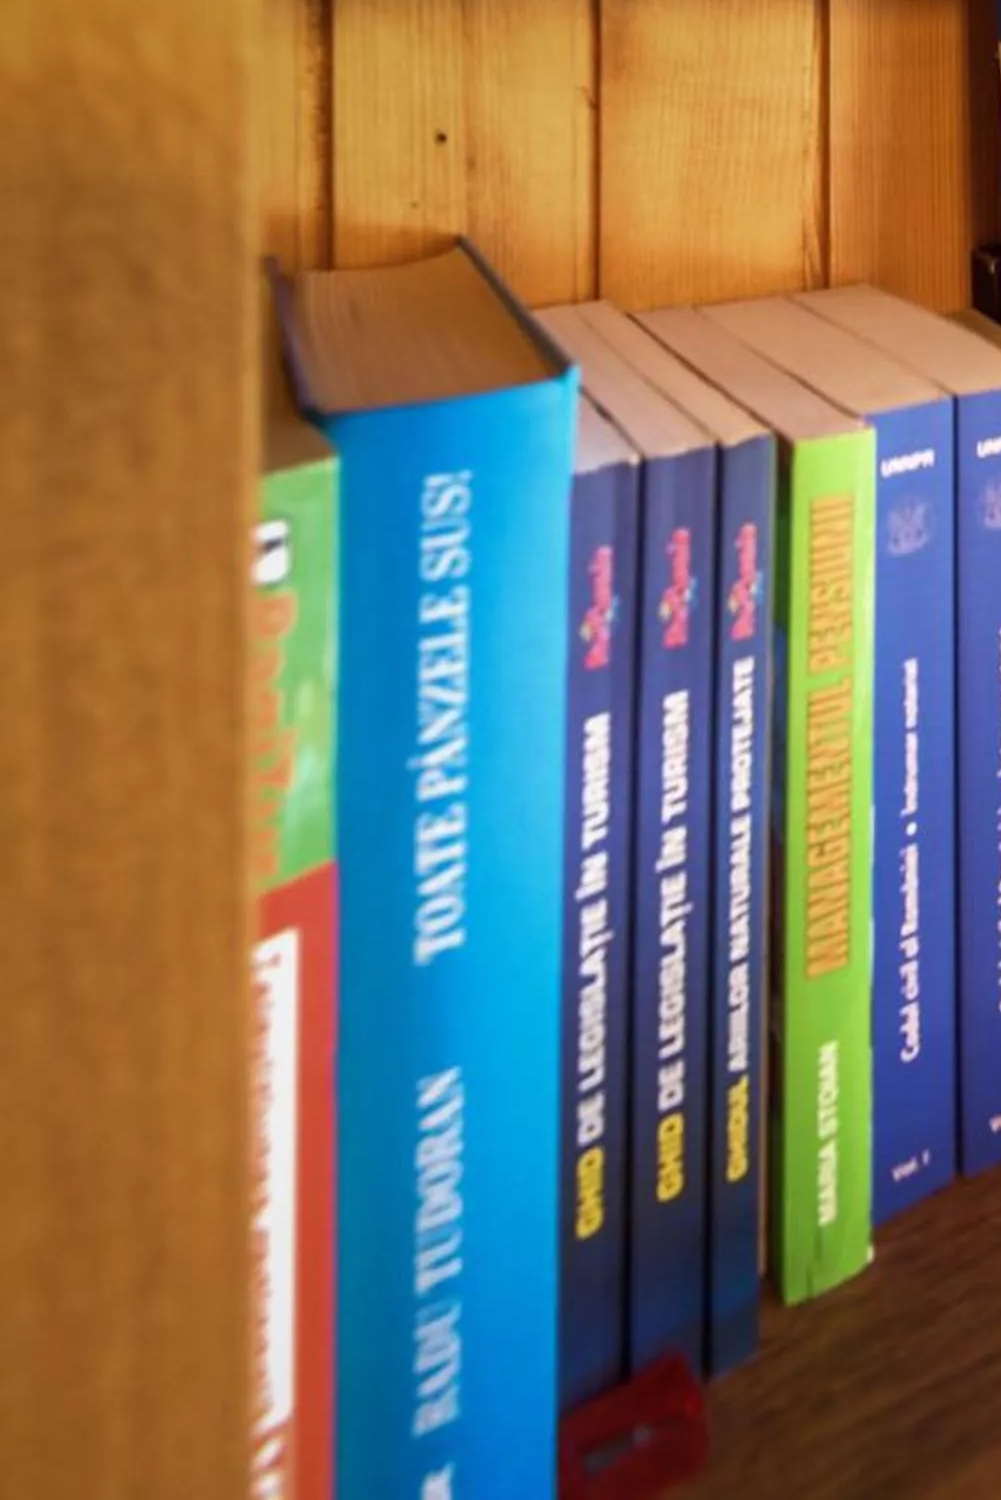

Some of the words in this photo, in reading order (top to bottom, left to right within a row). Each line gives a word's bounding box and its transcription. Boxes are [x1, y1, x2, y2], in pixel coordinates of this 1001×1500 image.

[419, 468, 474, 581] SUS!
[806, 490, 856, 673] PENSIUNII
[580, 710, 612, 849] TURISM
[661, 688, 689, 823] TURISM
[730, 655, 755, 811] PROTEJATE
[413, 802, 468, 963] TOATE
[728, 812, 752, 961] NATURALE
[803, 674, 854, 979] MANAGEMENTUL
[576, 1091, 606, 1146] DE
[656, 1059, 685, 1111] DE
[412, 1065, 464, 1295] TUDORAN
[575, 1146, 604, 1239] GHID
[655, 1112, 684, 1200] GHID
[412, 1300, 461, 1436] RADU
